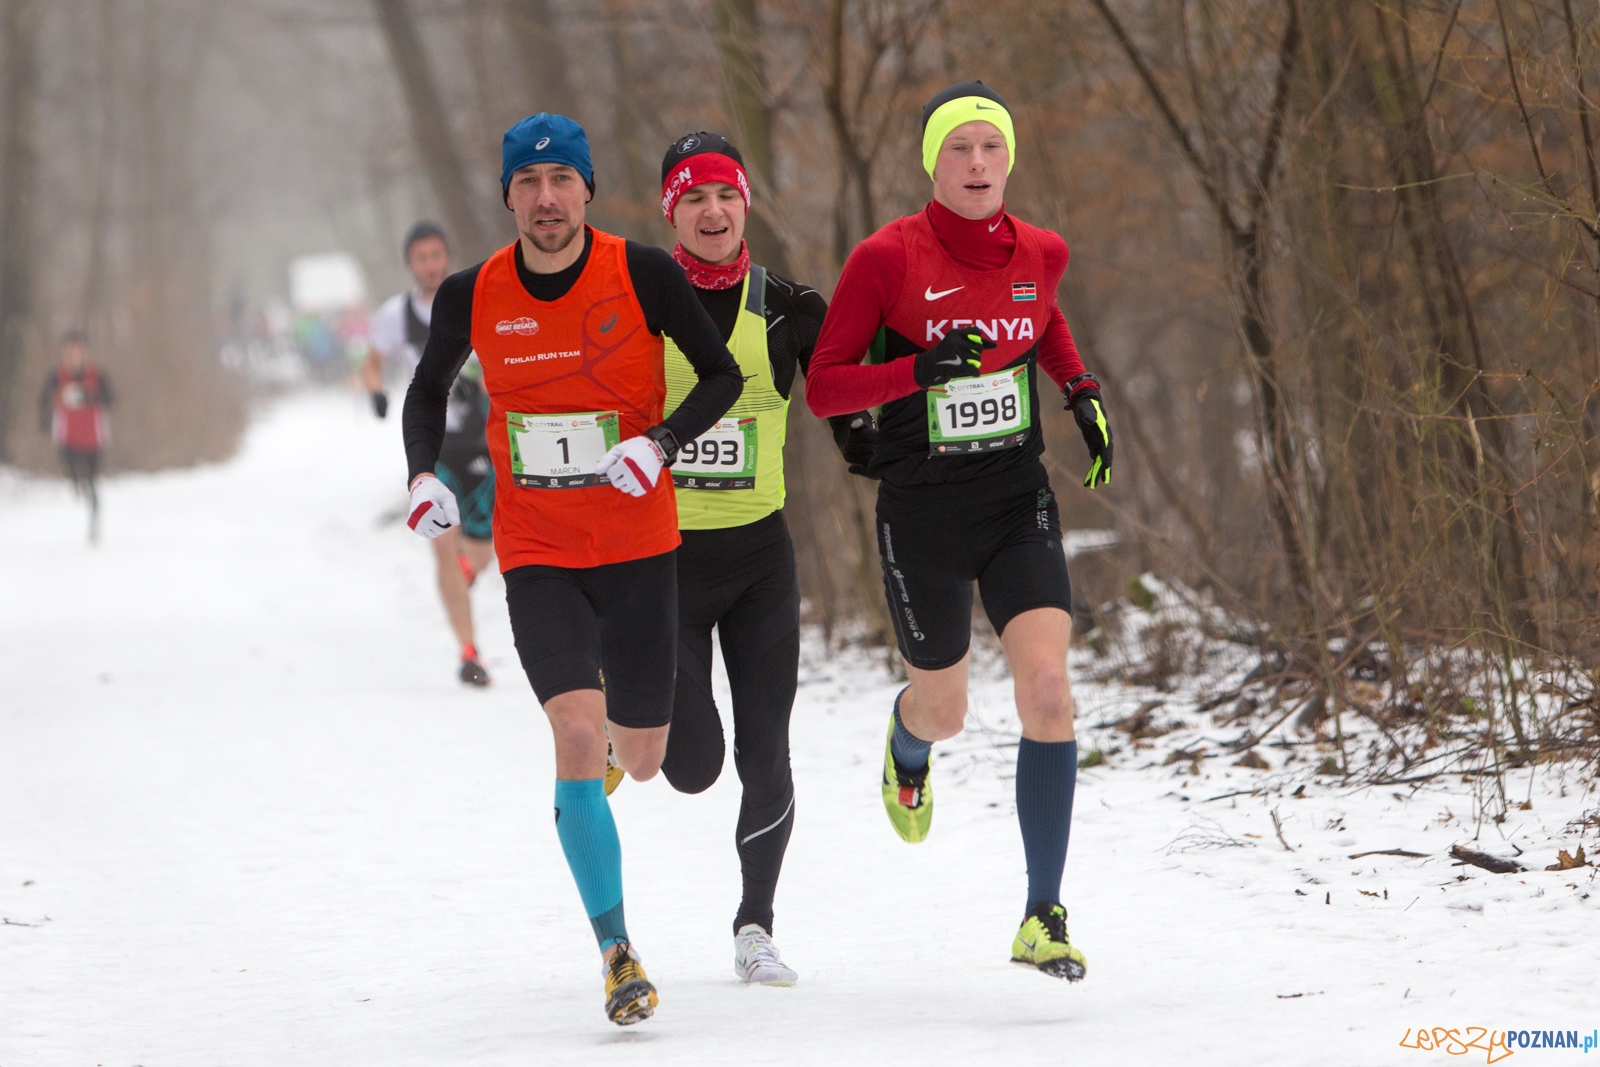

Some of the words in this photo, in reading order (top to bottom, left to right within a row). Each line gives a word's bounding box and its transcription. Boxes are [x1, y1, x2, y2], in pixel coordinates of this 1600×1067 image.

[537, 352, 557, 361] RUN
[558, 350, 581, 359] TEAM
[945, 394, 1017, 429] 1998
[556, 437, 570, 465] 1
[550, 466, 581, 475] MARCIN
